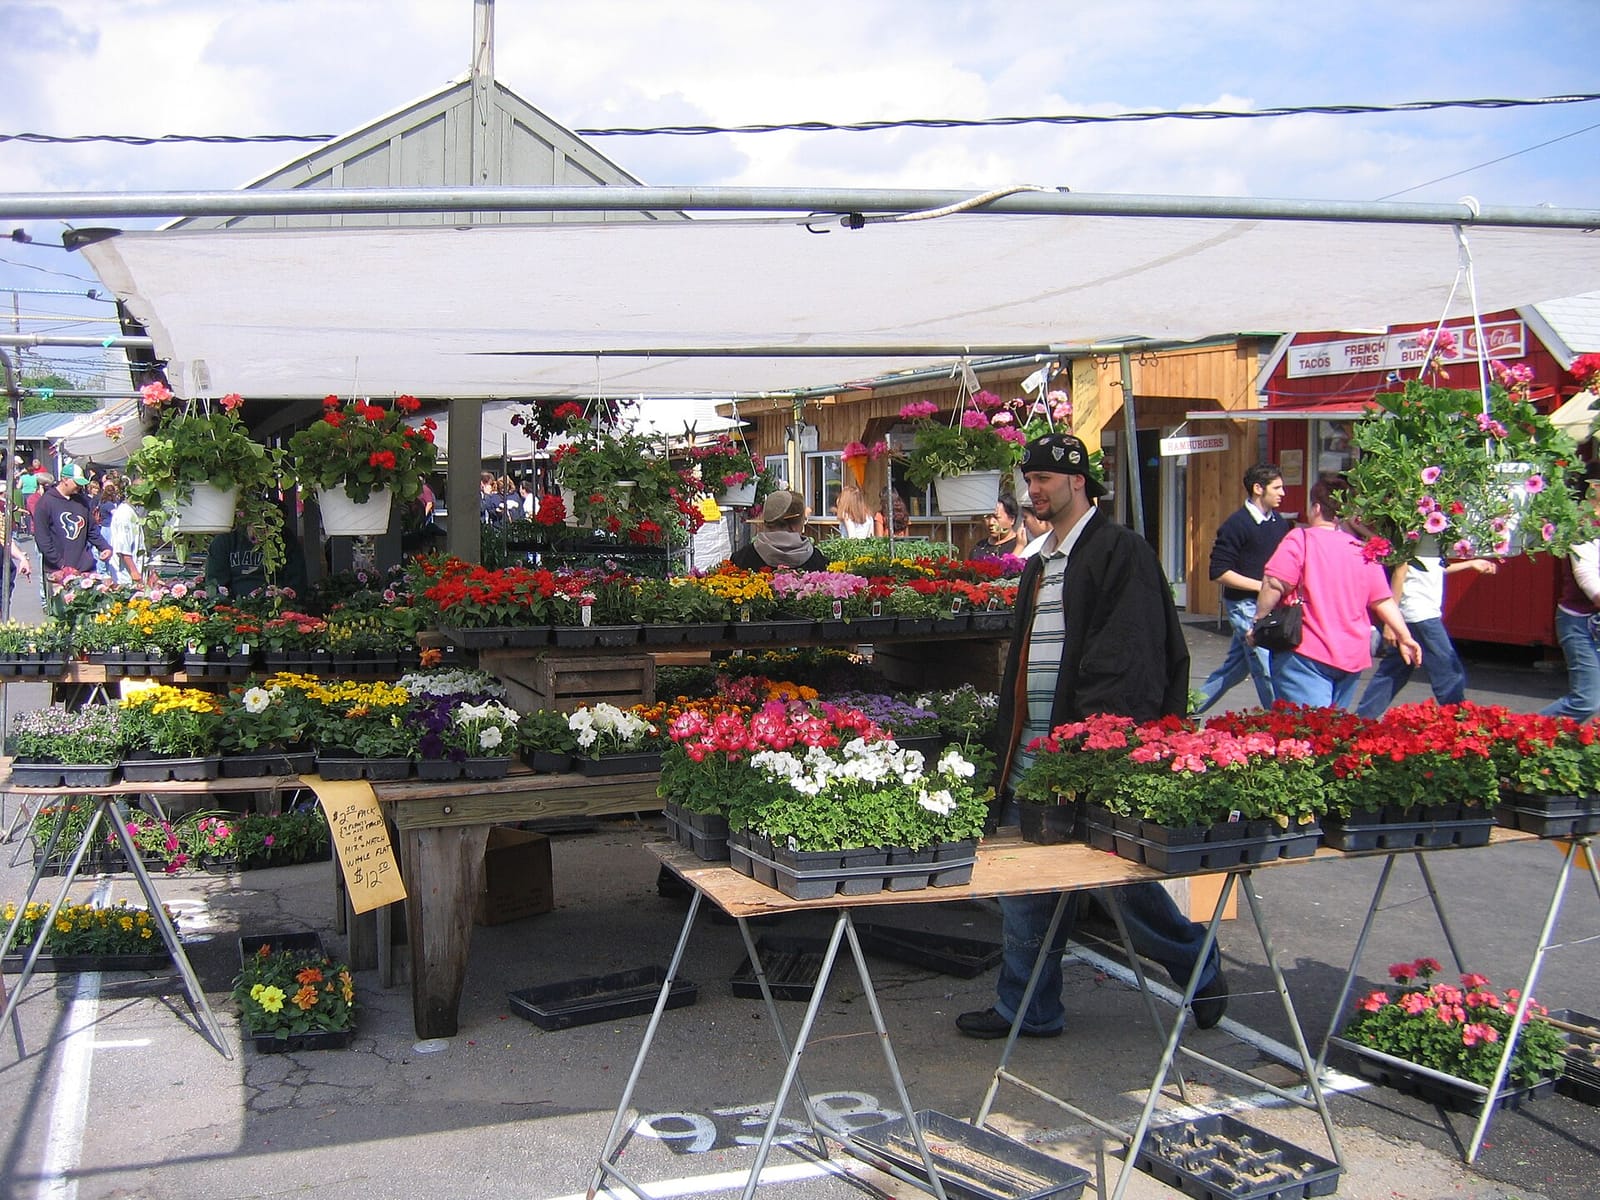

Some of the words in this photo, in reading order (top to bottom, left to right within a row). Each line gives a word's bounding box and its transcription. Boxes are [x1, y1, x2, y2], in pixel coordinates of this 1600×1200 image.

[1345, 342, 1385, 355] FRENCH
[1299, 357, 1331, 369] TACOS
[1350, 355, 1379, 367] FRIES
[1167, 438, 1224, 451] HAMBURGERS
[376, 844, 391, 857] FLAT
